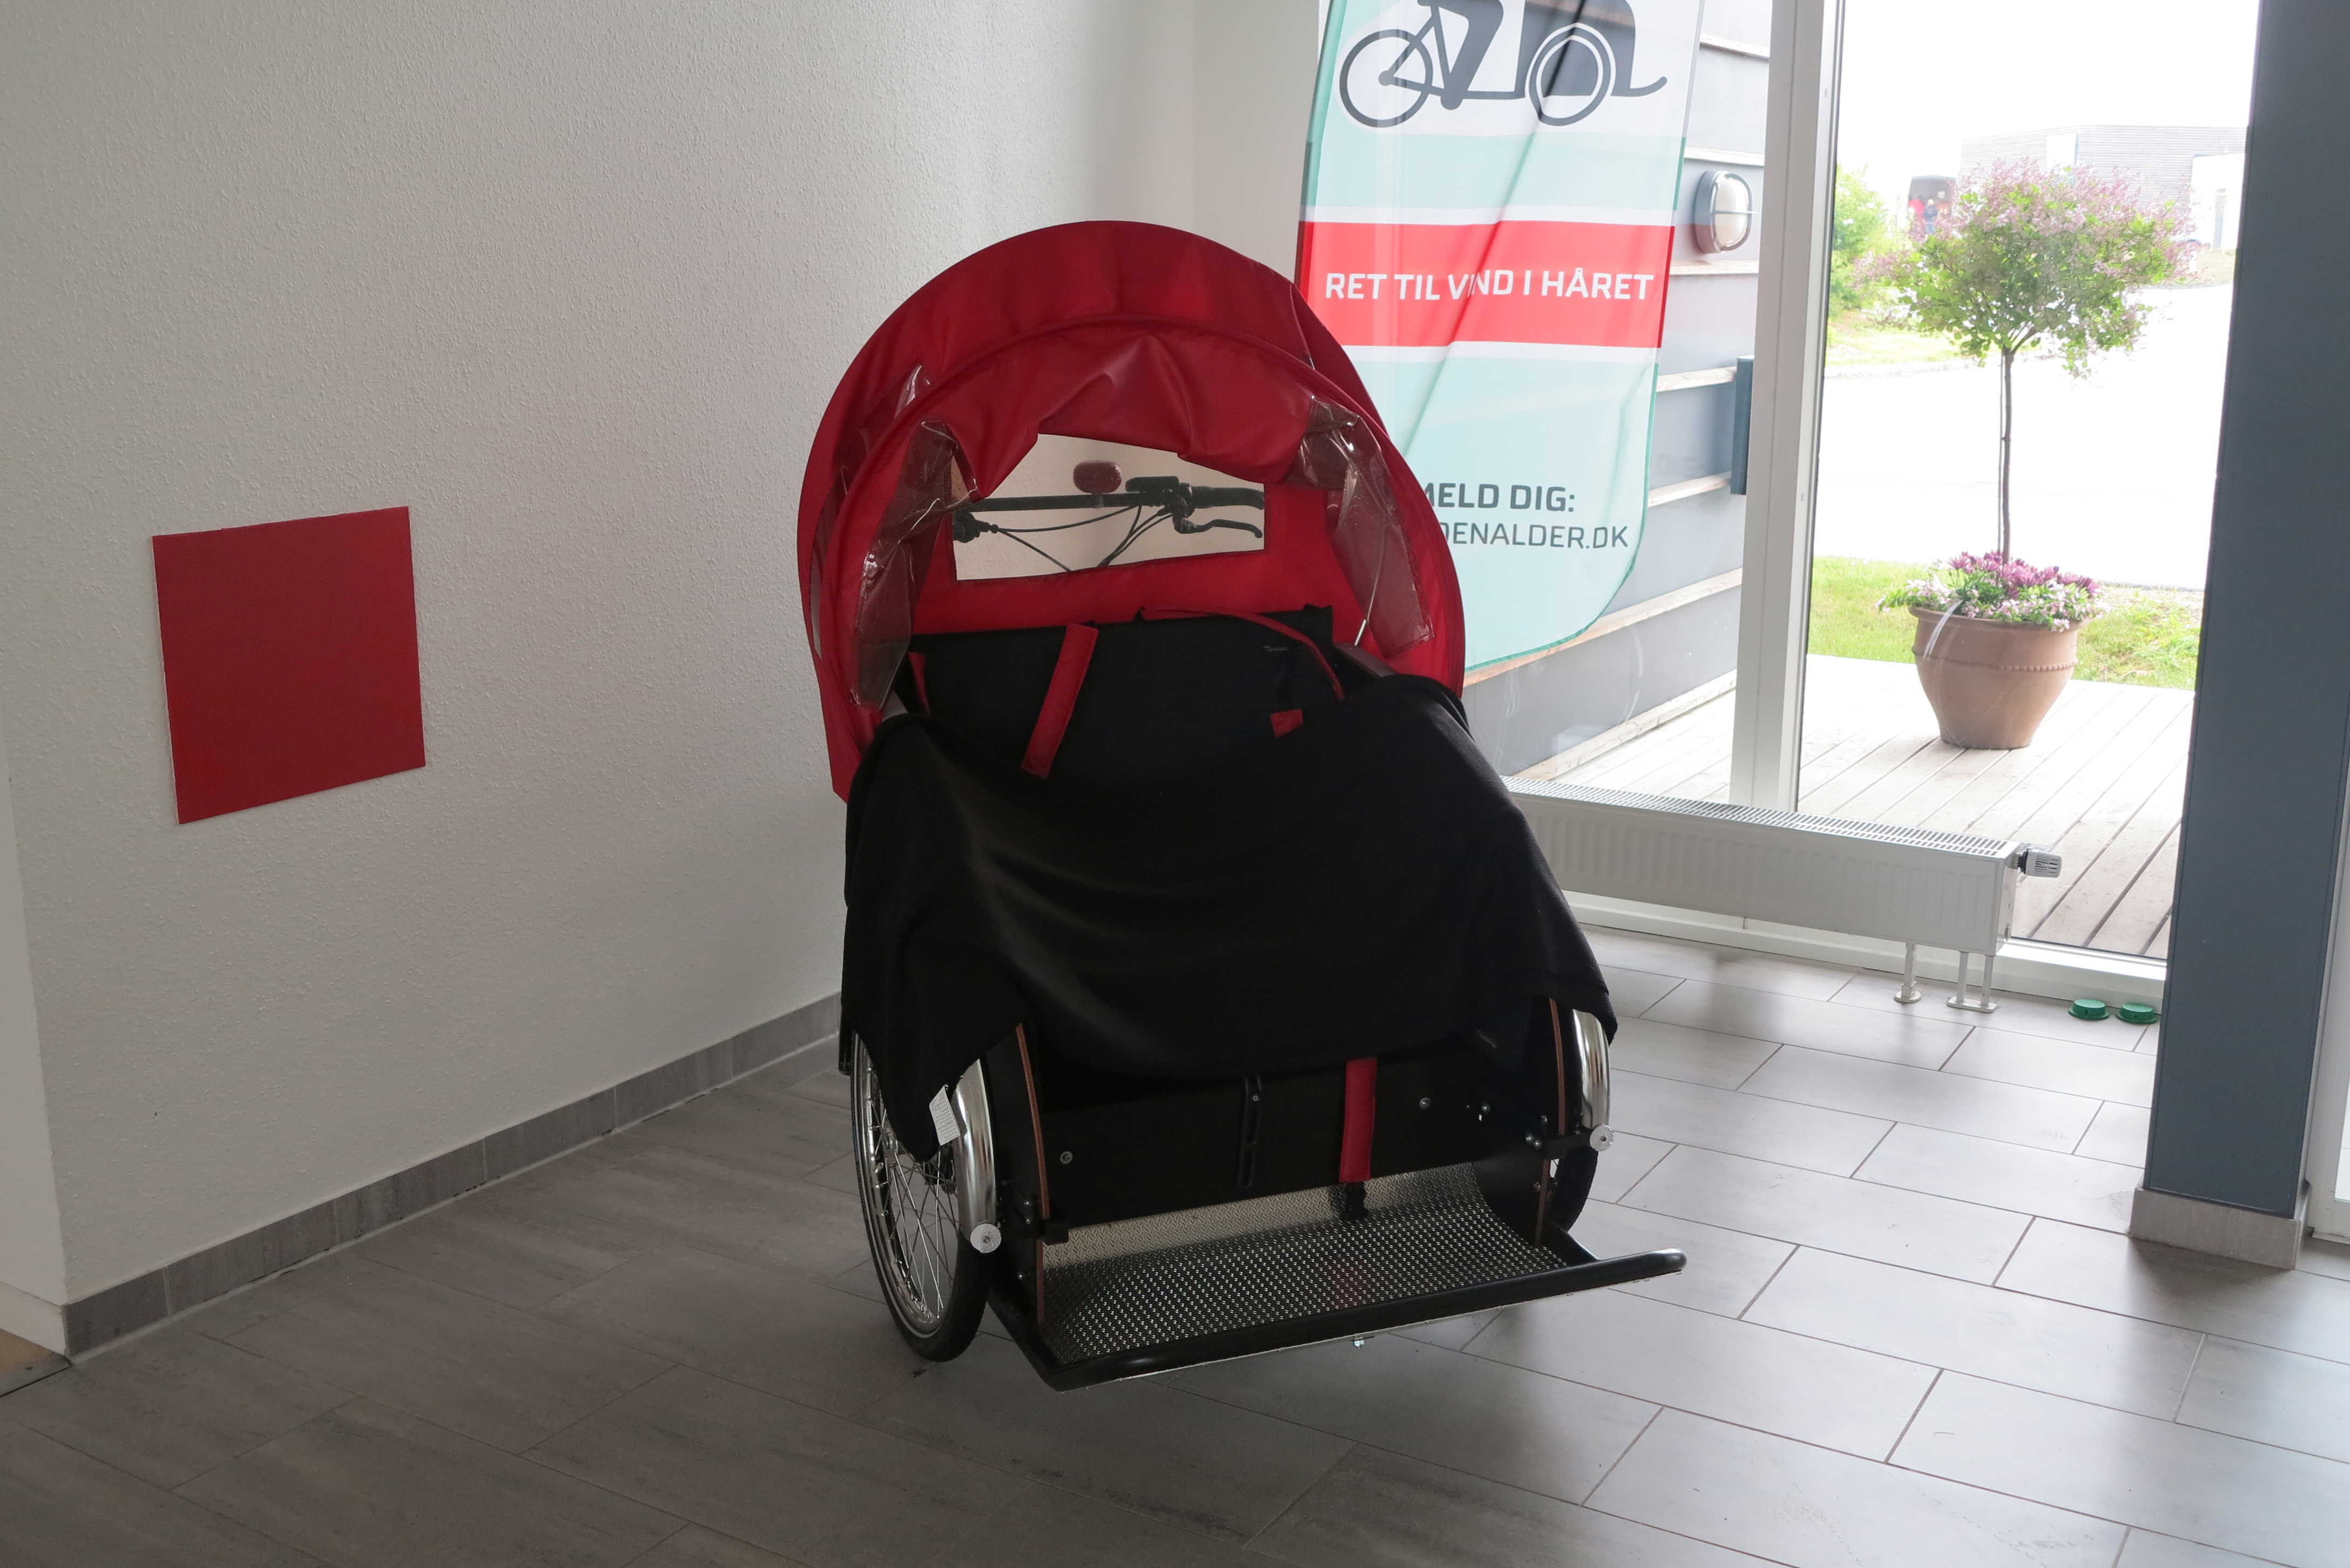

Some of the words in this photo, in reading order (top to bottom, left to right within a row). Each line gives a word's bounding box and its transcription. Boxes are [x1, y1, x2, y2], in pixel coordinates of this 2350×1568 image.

[1325, 273, 1387, 300] RET
[1394, 274, 1440, 300] TIL
[1523, 270, 1532, 296] I
[1541, 267, 1654, 300] HÅRET
[1510, 484, 1575, 512] DIG:
